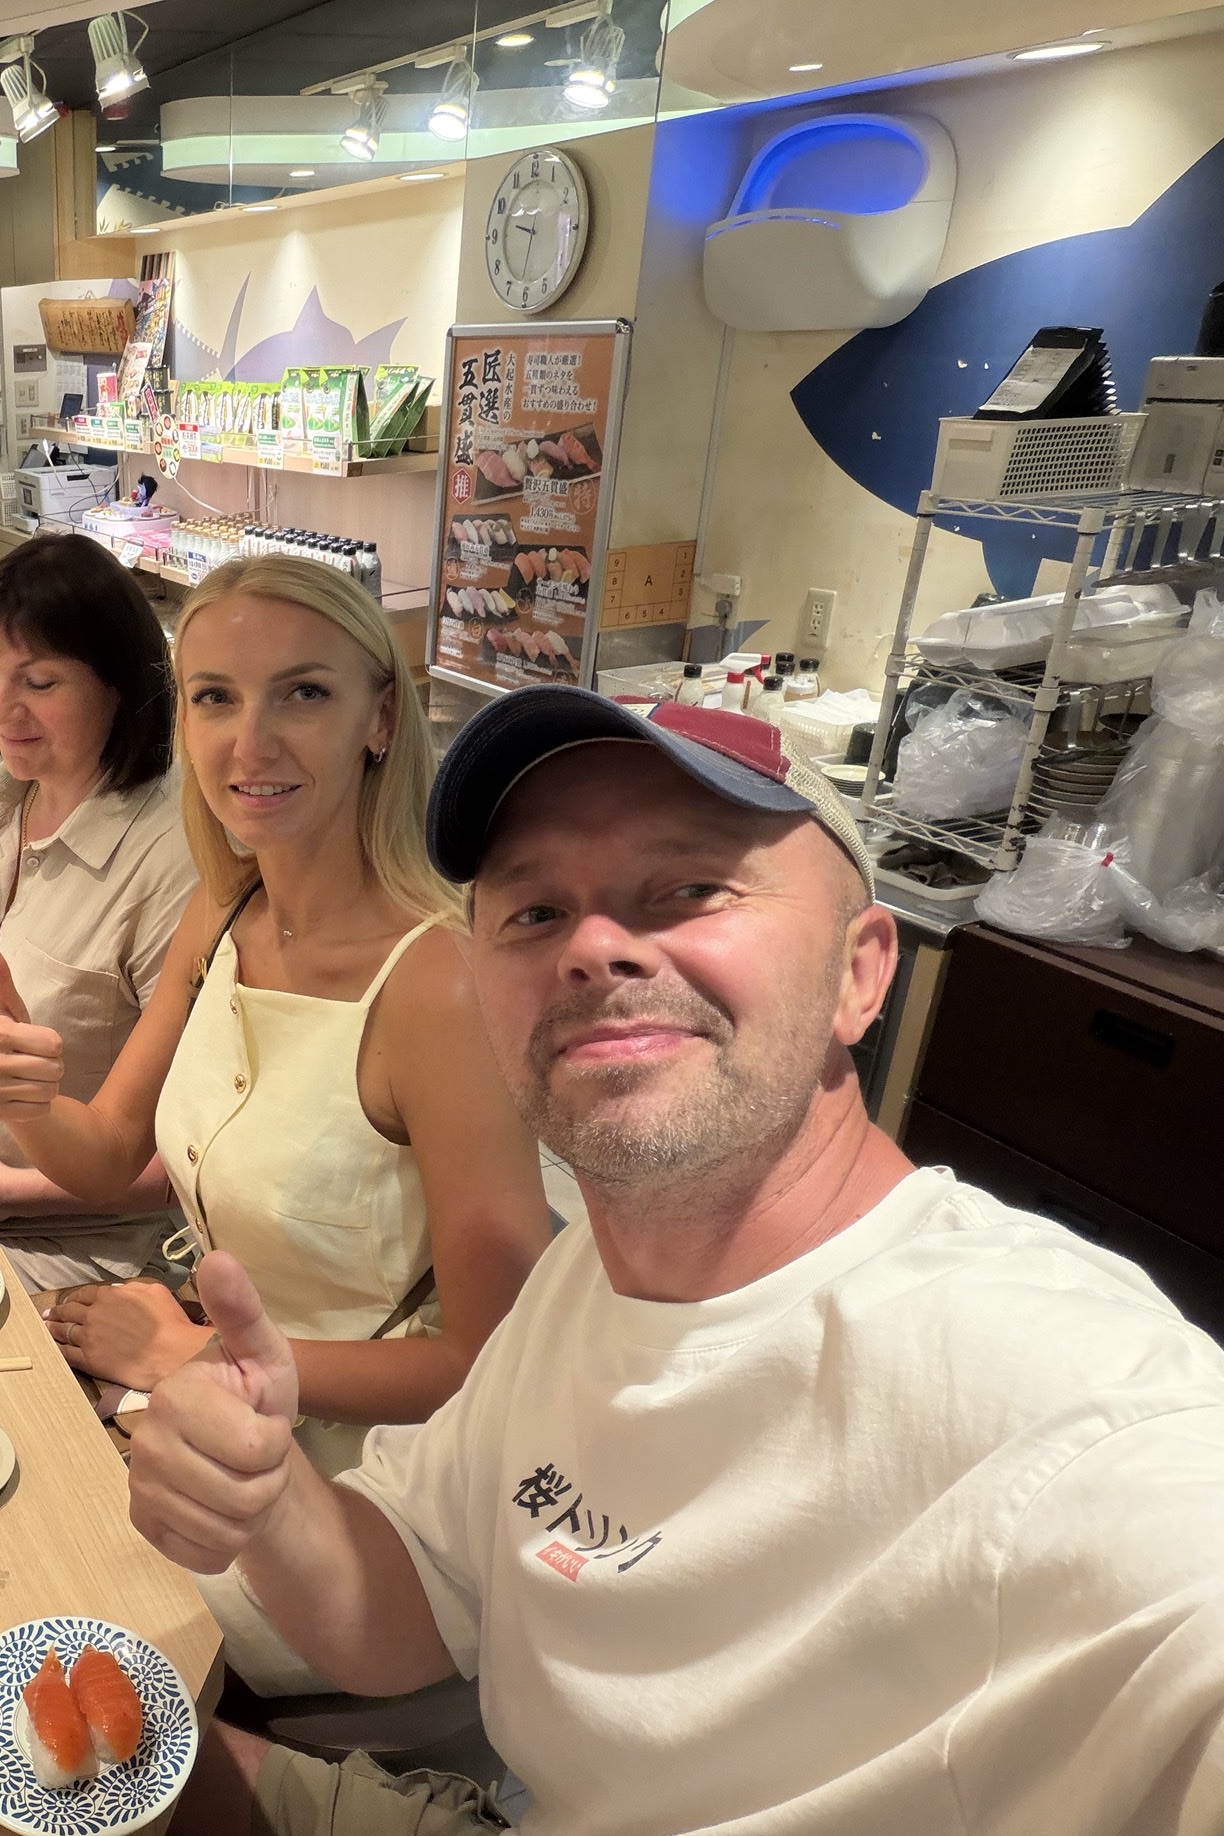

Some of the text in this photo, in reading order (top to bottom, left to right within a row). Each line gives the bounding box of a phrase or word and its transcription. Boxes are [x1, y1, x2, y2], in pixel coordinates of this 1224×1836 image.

[491, 229, 498, 244] 9
[494, 260, 500, 275] 8
[503, 353, 516, 421] 大起水産の
[455, 474, 469, 499] 推
[614, 559, 620, 567] 9
[680, 570, 686, 578] 2
[612, 577, 618, 586] 8
[644, 575, 653, 587] A
[679, 588, 684, 596] 3
[610, 595, 616, 603] 7
[624, 612, 630, 620] 6
[642, 610, 647, 618] 5
[659, 608, 665, 616] 4
